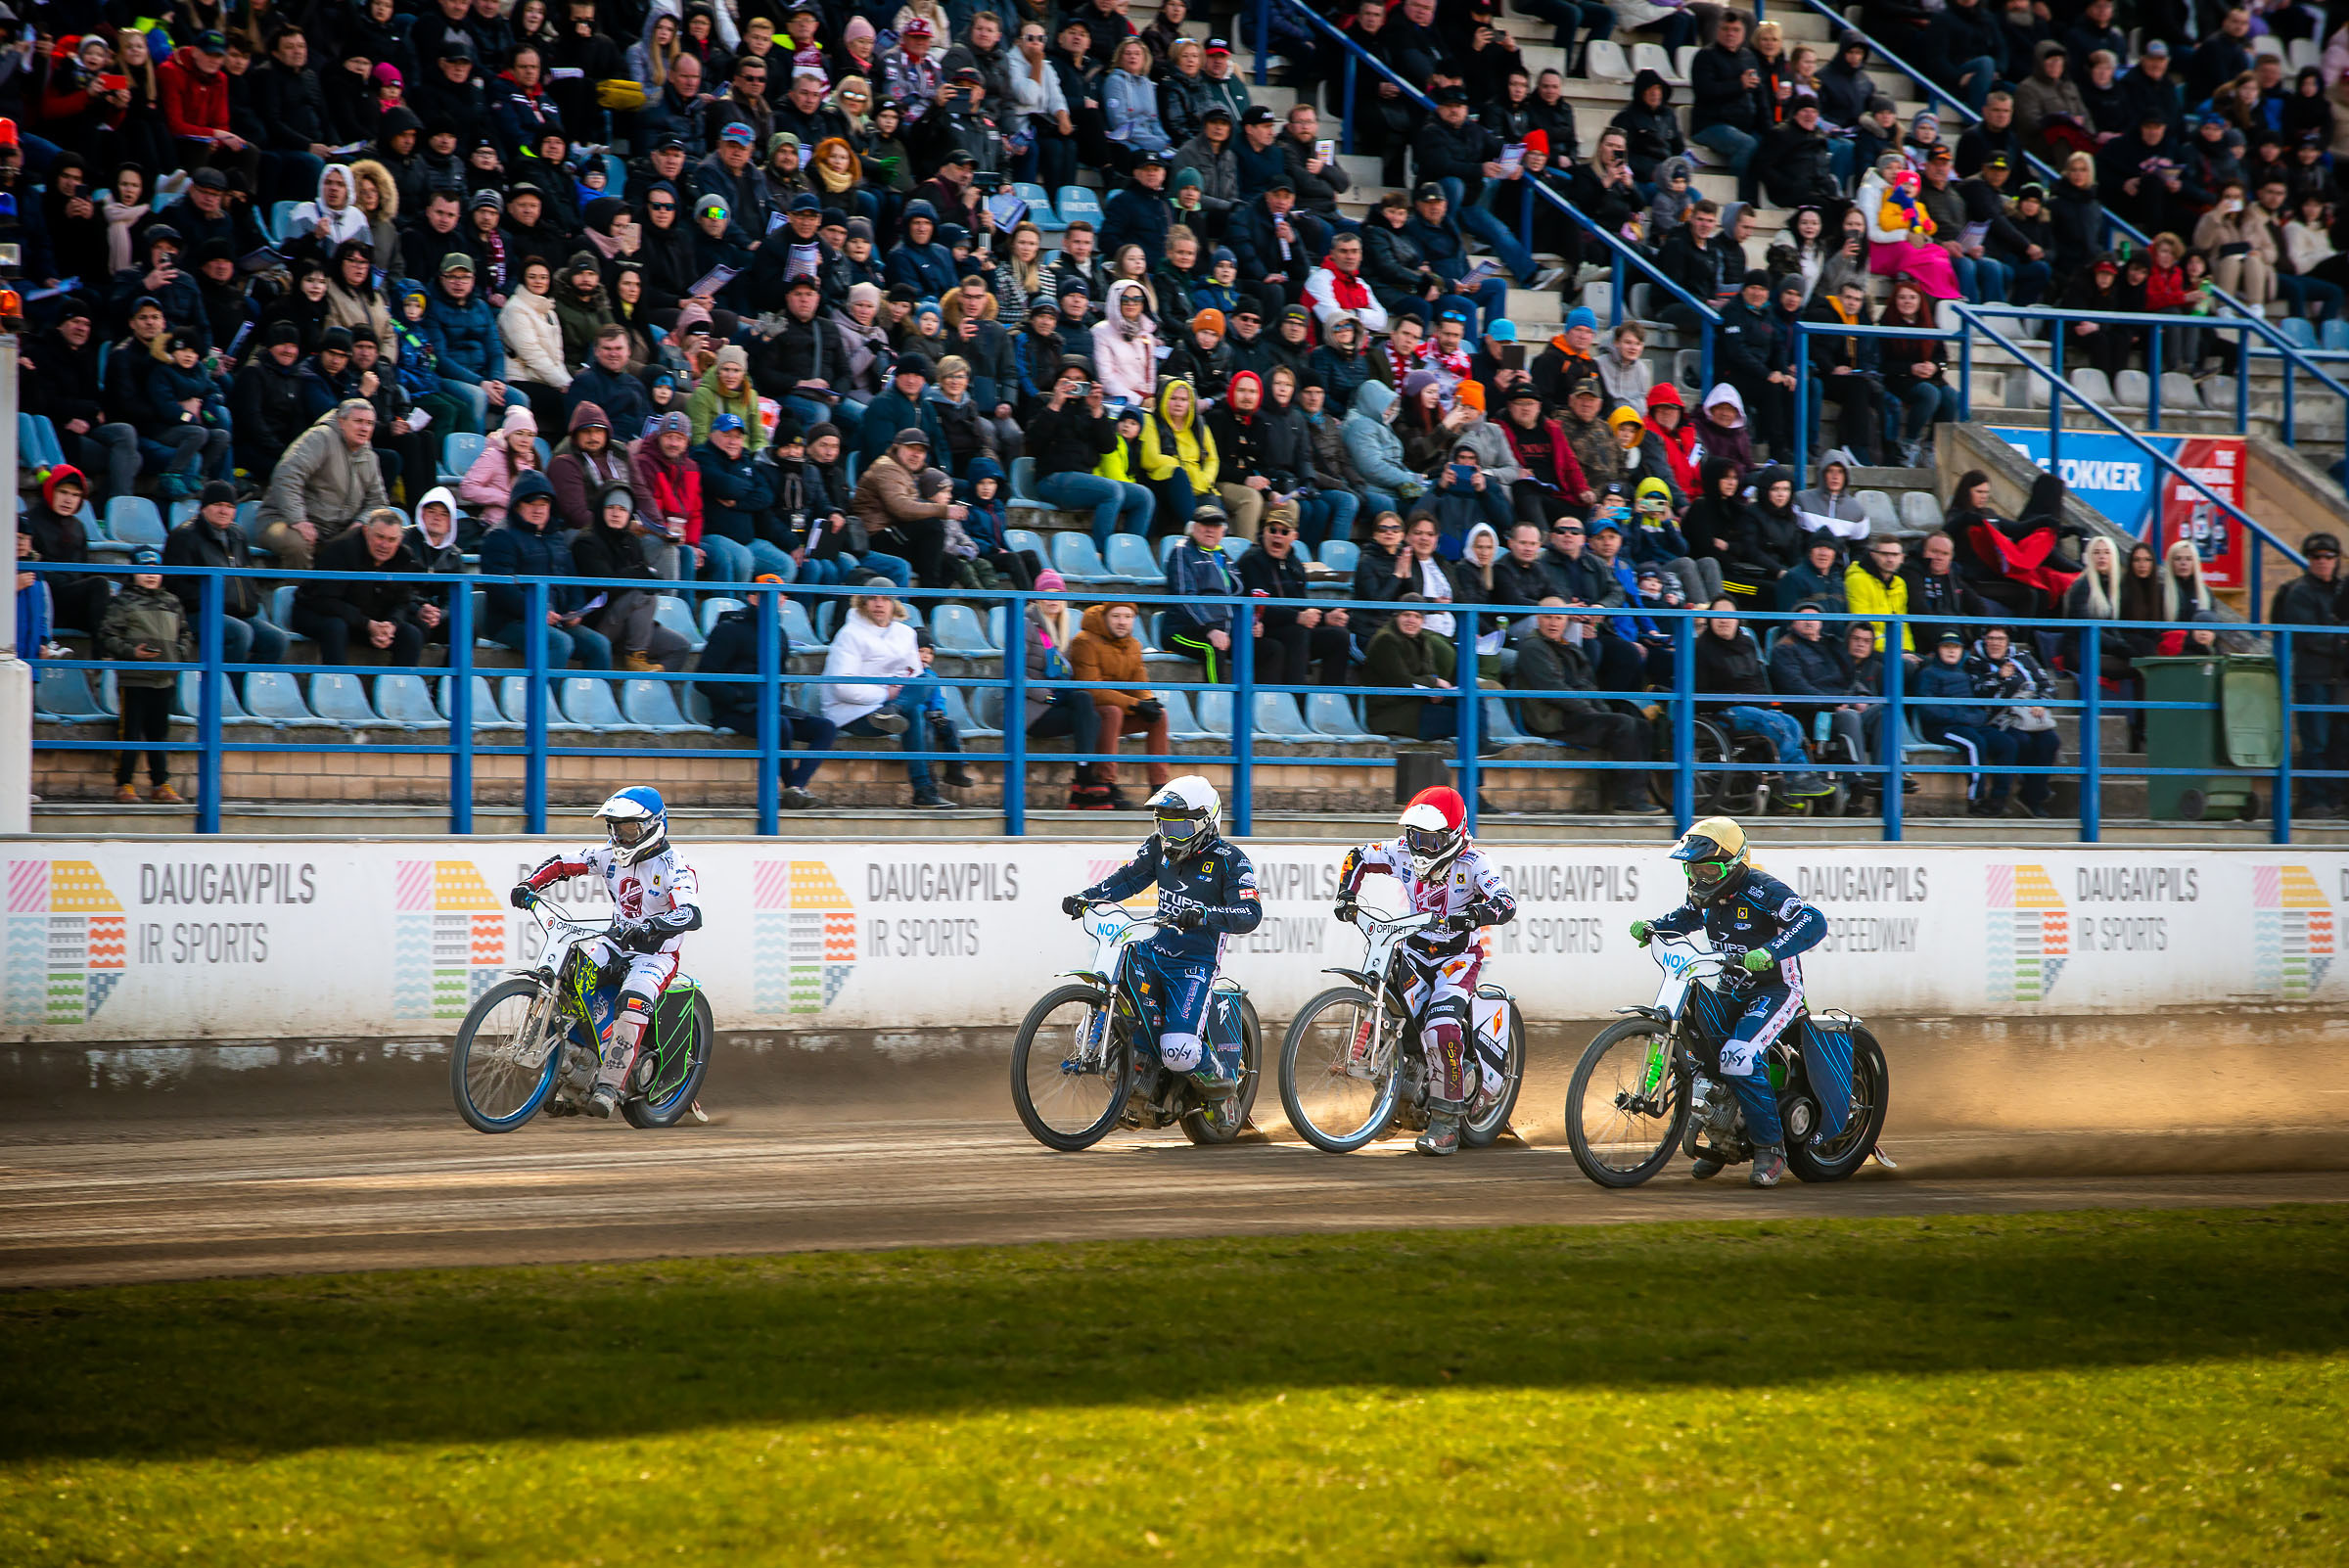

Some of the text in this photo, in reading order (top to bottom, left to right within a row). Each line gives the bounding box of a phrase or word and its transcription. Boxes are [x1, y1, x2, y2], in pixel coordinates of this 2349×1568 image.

[139, 862, 317, 905] DAUGAVPILS
[867, 862, 1019, 902] DAUGAVPILS
[1259, 862, 1338, 901] AVPILS
[1501, 865, 1640, 902] DAUGAVPILS
[1797, 866, 1928, 902] DAUGAVPILS
[2076, 867, 2199, 902] DAUGAVPILS
[139, 923, 268, 964] IR SPORTS
[556, 921, 586, 937] OPTIBET
[867, 918, 979, 957] IR SPORTS
[1376, 924, 1407, 935] OPTIBET
[1501, 918, 1604, 954] IR SPORTS
[1821, 917, 1919, 953] SPEEDWAY
[2077, 917, 2169, 951] IR SPORTS
